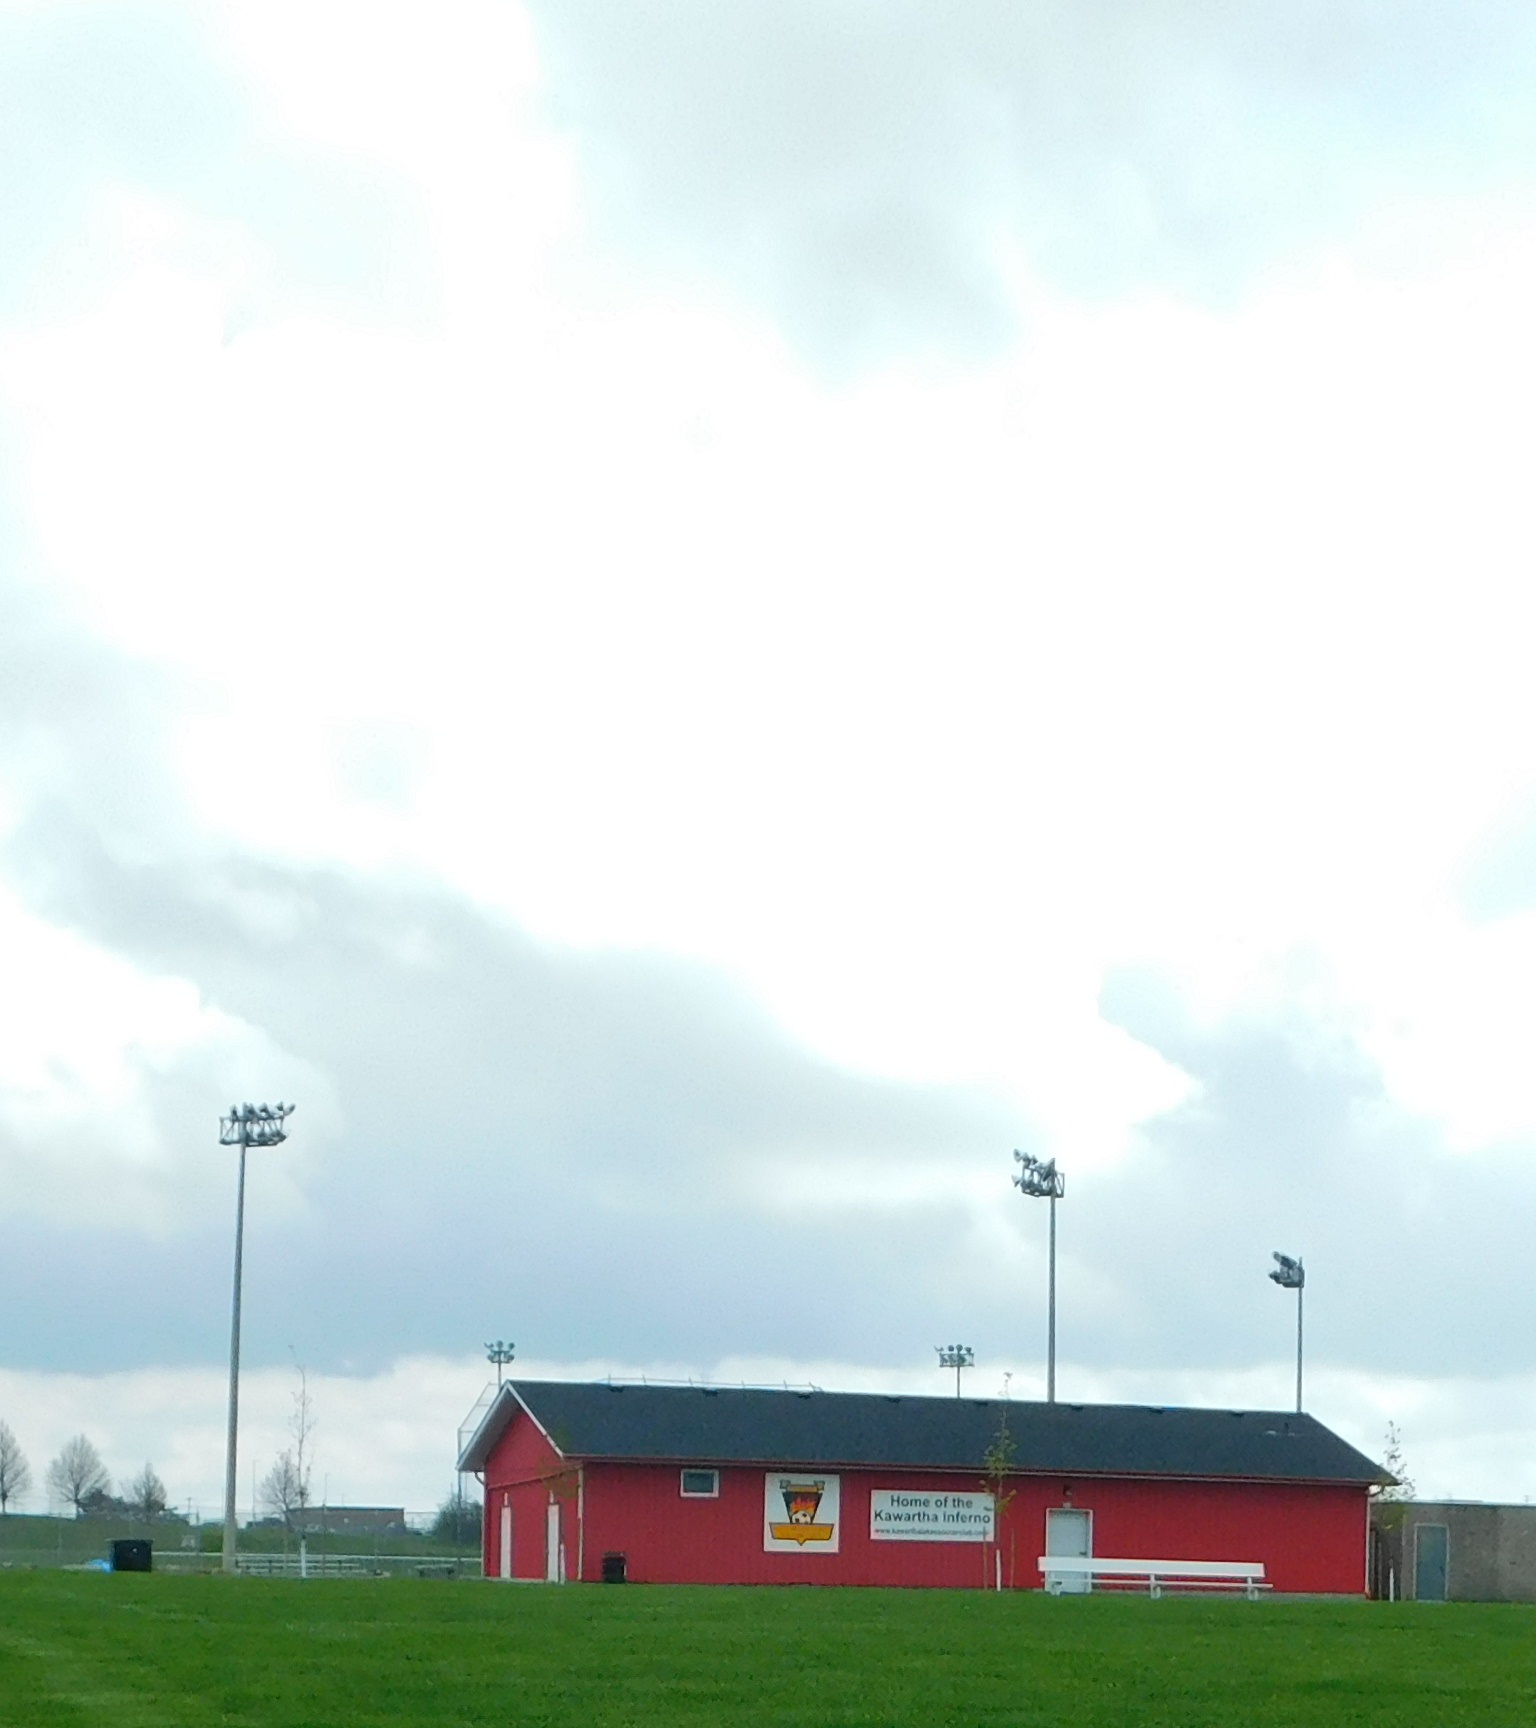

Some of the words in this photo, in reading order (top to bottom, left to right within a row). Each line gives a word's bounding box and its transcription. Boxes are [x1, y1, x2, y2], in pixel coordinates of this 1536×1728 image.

[891, 1495, 930, 1508] Home
[935, 1496, 948, 1508] of
[952, 1497, 973, 1508] the
[874, 1510, 938, 1522] Kawartha
